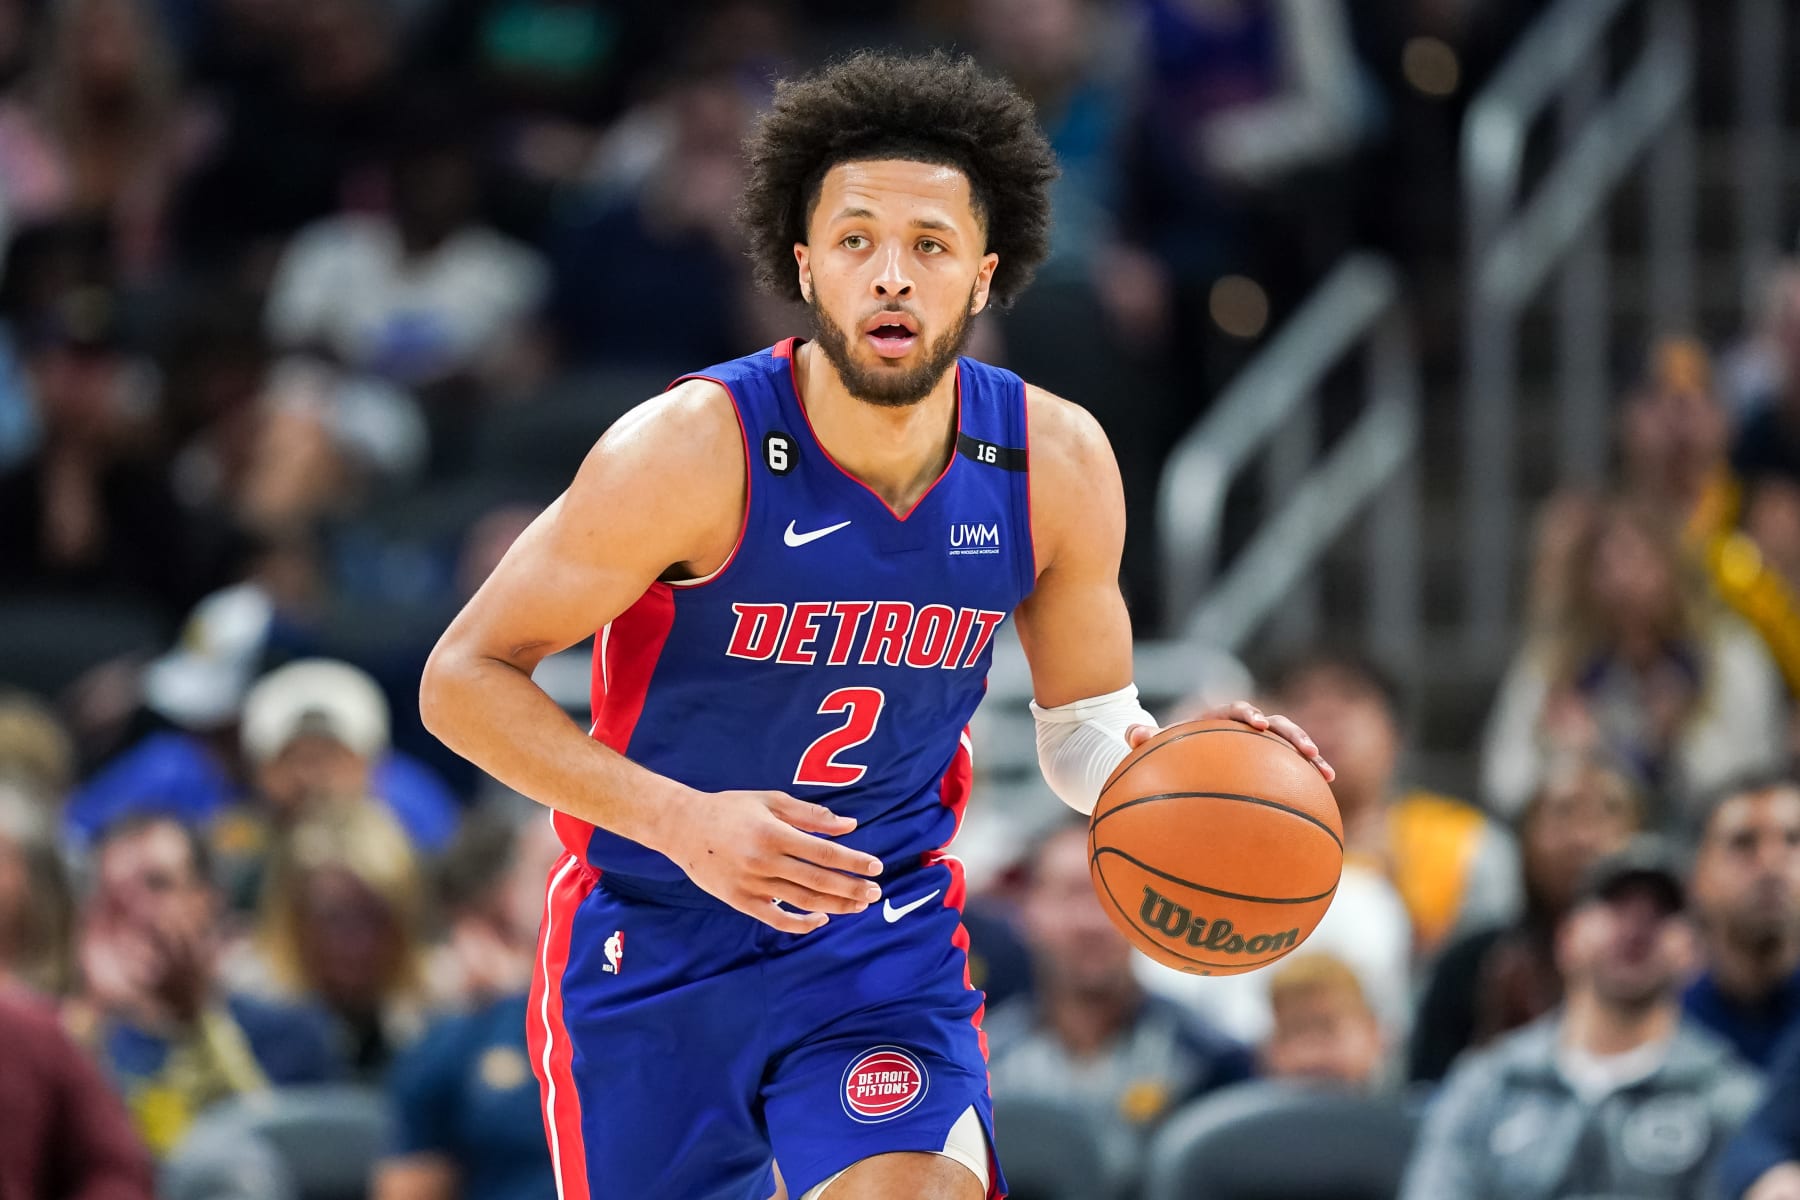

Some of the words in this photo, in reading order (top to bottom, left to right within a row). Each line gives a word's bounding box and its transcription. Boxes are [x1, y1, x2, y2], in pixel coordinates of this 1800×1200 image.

[768, 437, 788, 471] 6
[977, 444, 997, 464] 16
[950, 523, 999, 547] UWM
[725, 601, 1006, 670] DETROIT
[792, 686, 885, 787] 2
[1139, 884, 1300, 955] Wilson
[856, 1083, 910, 1098] PISTONS
[857, 1071, 910, 1086] DETROIT
